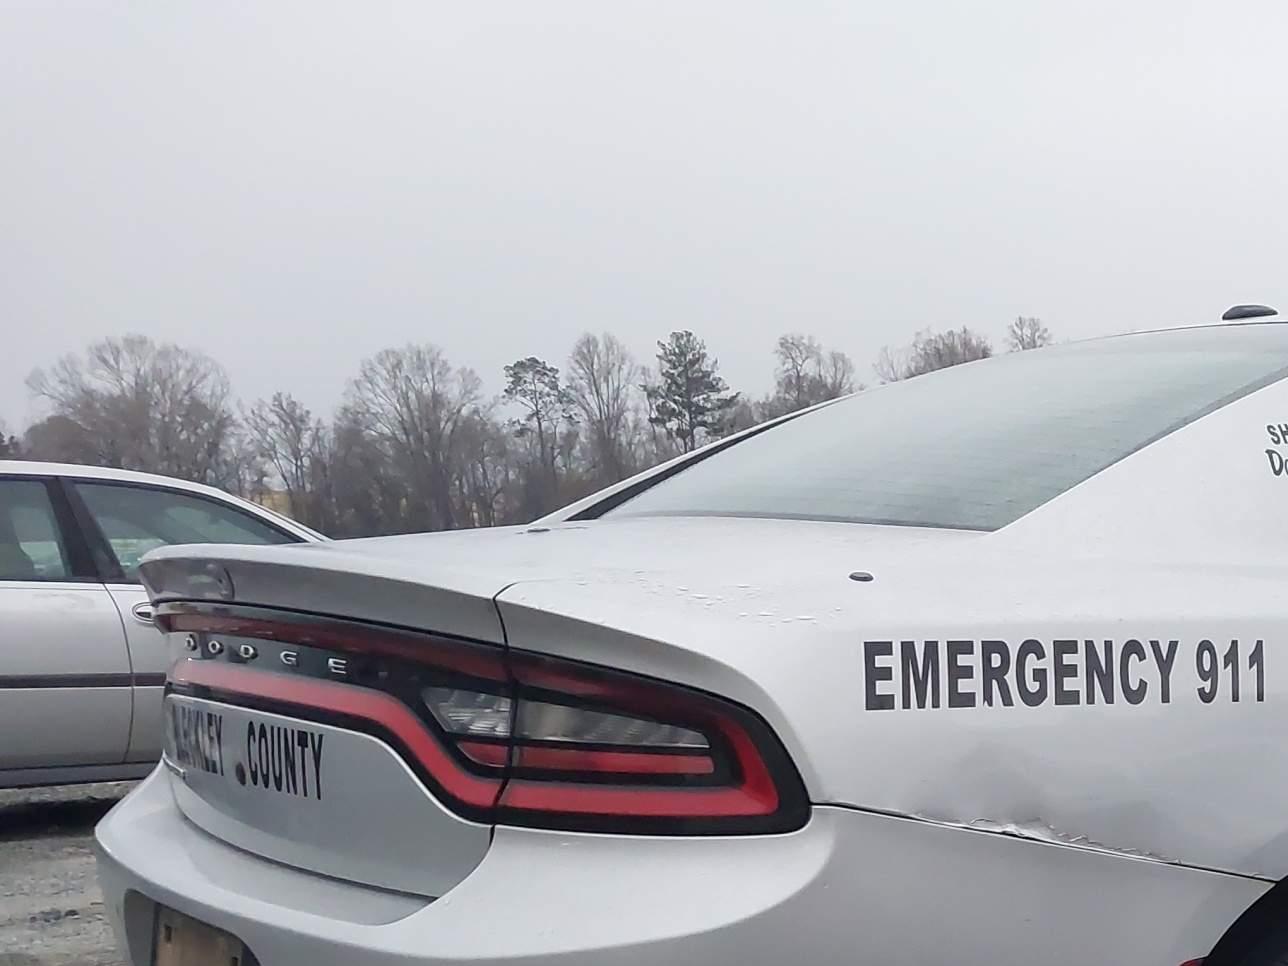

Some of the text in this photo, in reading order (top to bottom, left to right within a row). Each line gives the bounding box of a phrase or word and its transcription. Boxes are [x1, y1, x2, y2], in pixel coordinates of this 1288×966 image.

[184, 633, 348, 675] DODGE
[863, 639, 1265, 711] EMERGENCY 911
[247, 721, 324, 800] COUNTY
